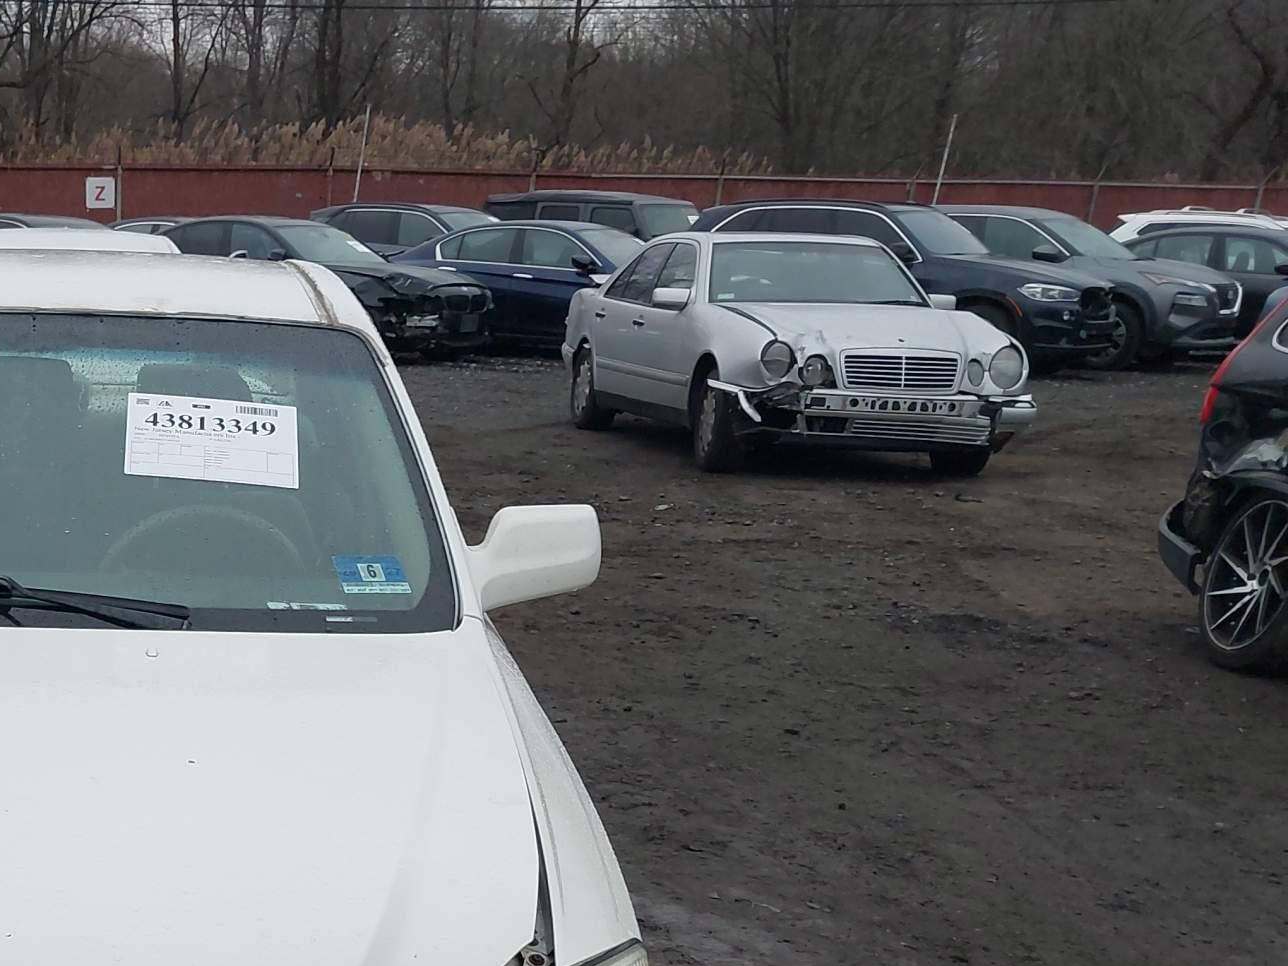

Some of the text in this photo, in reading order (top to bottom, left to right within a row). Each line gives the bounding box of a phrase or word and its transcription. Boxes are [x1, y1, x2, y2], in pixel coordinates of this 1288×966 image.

[95, 185, 105, 201] Z
[144, 412, 276, 437] 43813349
[366, 564, 378, 578] 6
